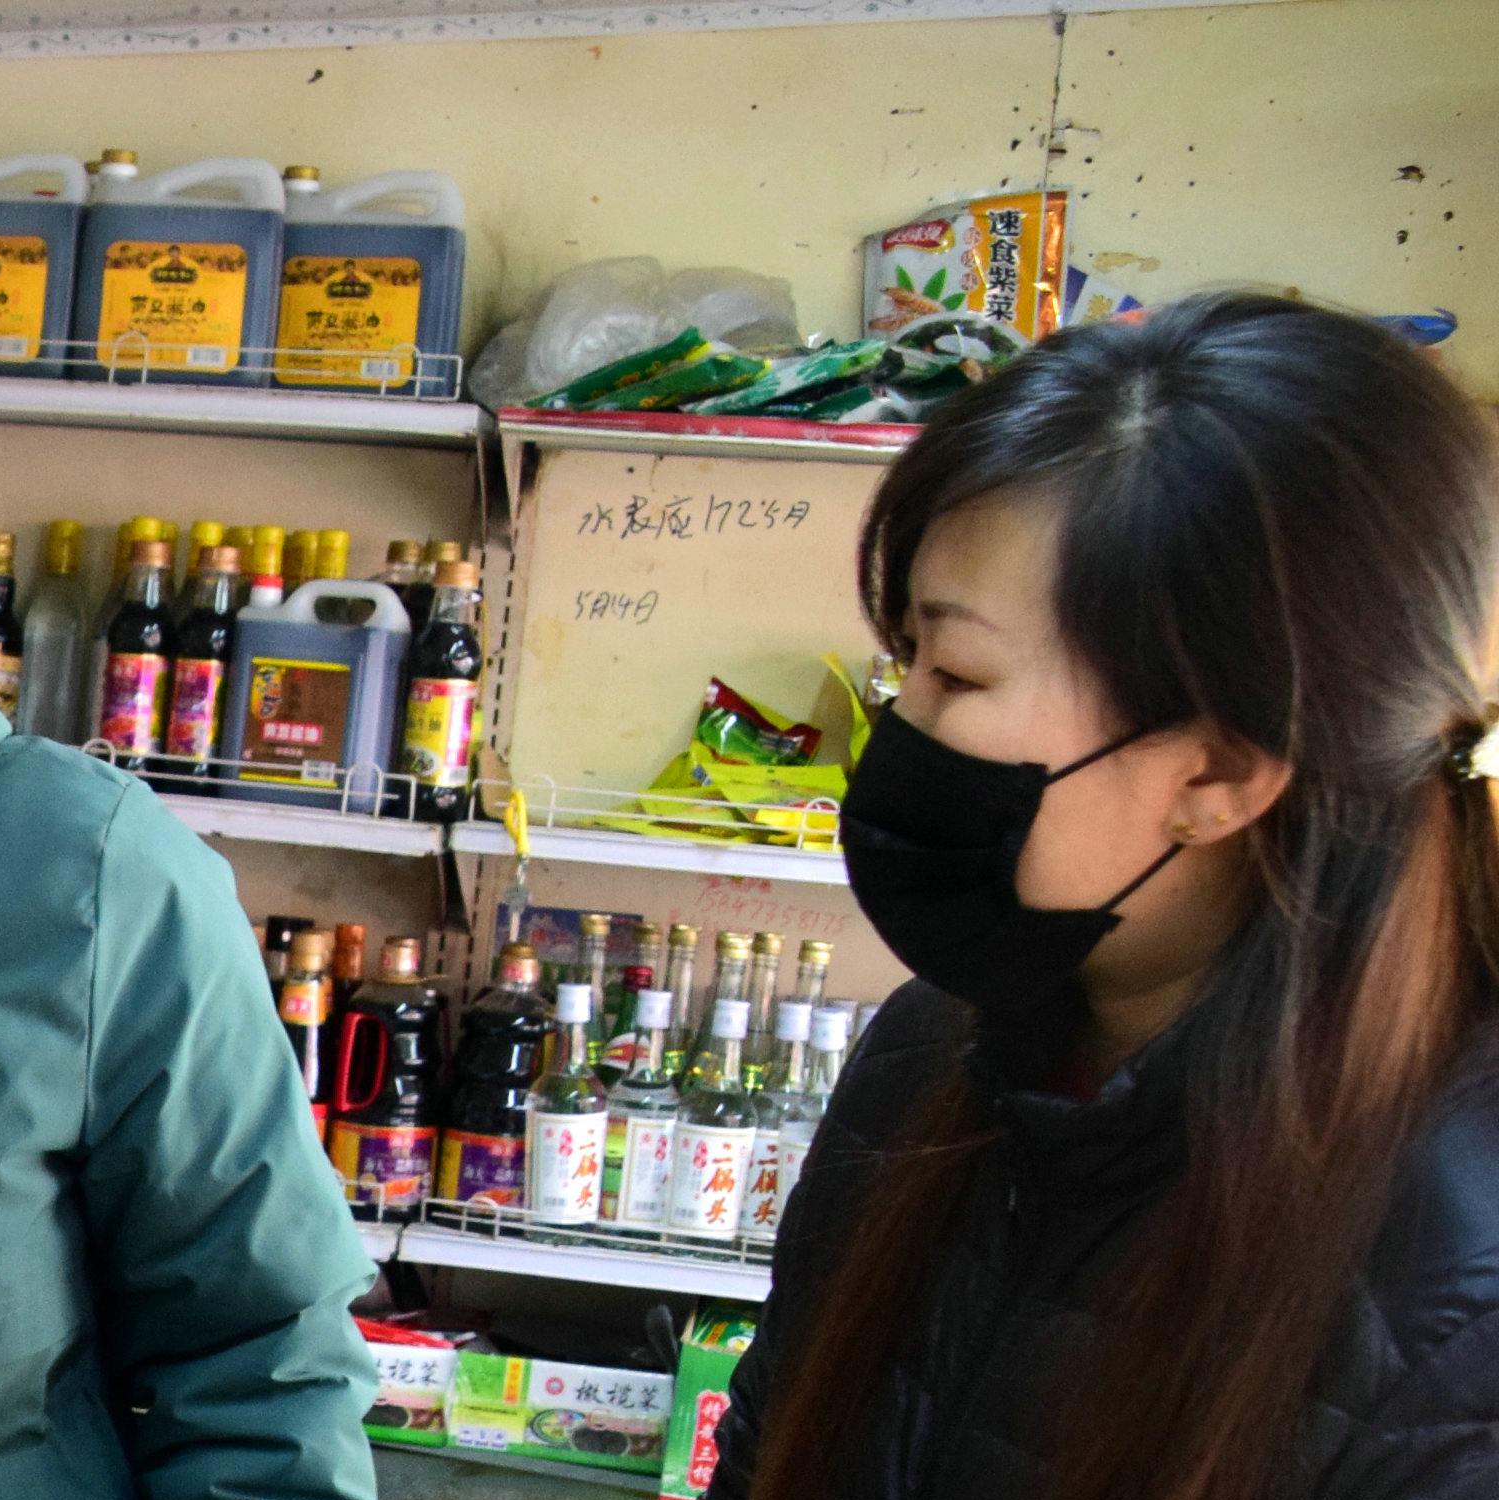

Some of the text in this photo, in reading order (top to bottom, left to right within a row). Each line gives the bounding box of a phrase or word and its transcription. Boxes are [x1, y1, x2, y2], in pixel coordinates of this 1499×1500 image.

[987, 208, 1021, 321] 速食紫菜
[375, 1357, 440, 1385] 榄菜
